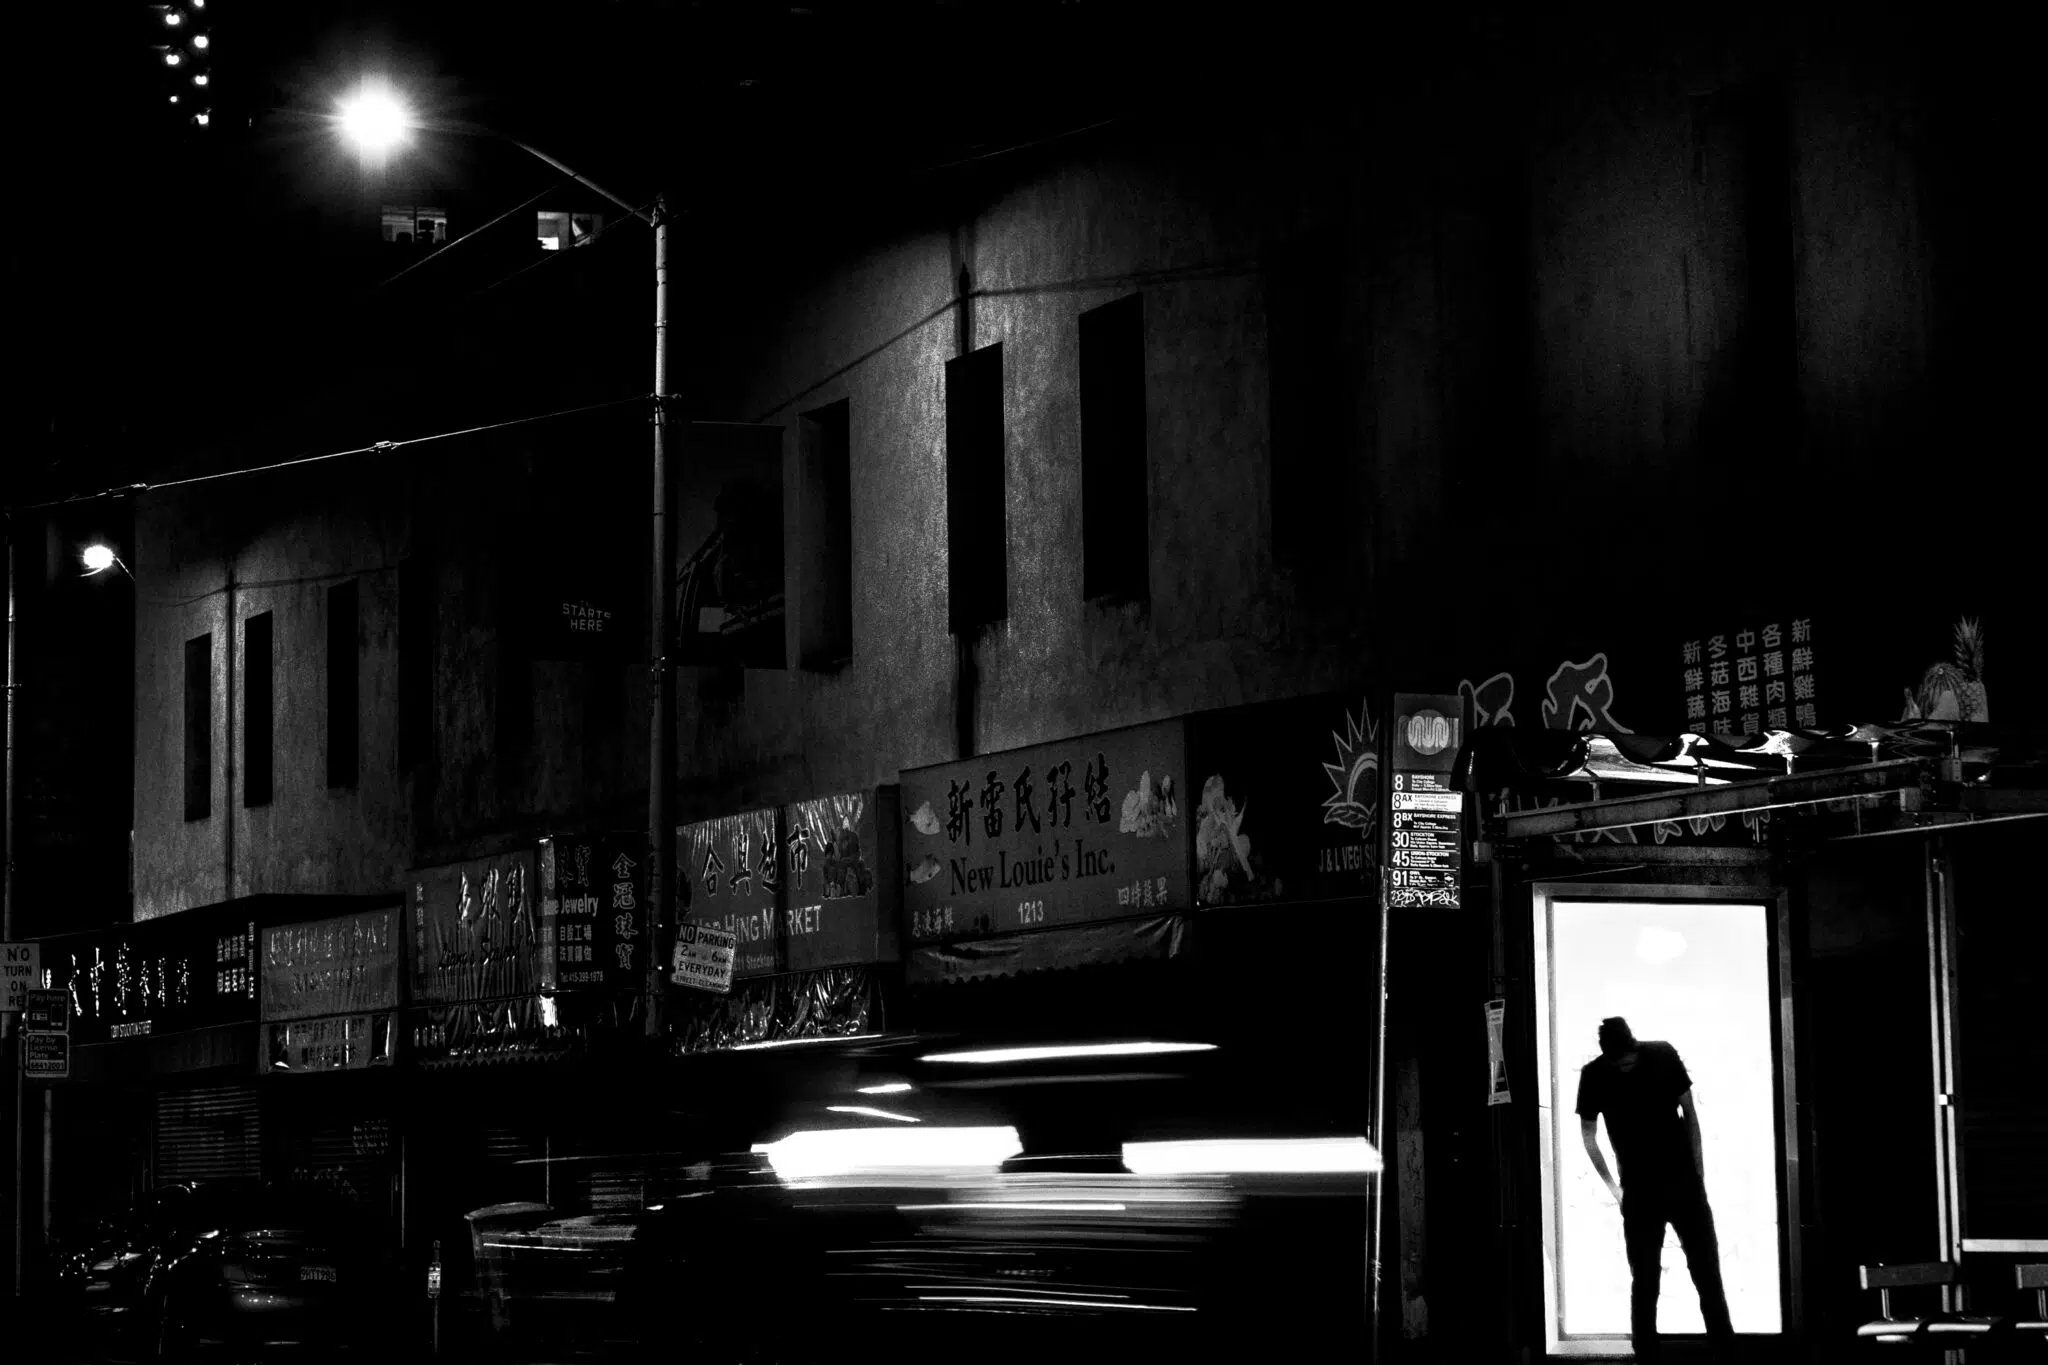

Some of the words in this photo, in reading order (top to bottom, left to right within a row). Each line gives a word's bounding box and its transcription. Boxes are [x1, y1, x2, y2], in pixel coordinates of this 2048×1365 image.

[570, 619, 605, 633] HERE
[1394, 774, 1404, 791] 8
[1392, 831, 1410, 848] 30
[1392, 850, 1410, 867] 45
[950, 857, 995, 896] New
[999, 839, 1070, 889] Louie's
[1075, 839, 1116, 879] Inc.
[1392, 870, 1408, 886] 91
[560, 892, 599, 918] Jewelry
[1017, 900, 1044, 925] 1213
[679, 924, 695, 944] NO
[697, 931, 735, 950] PARKING
[7, 947, 30, 962] NO
[4, 965, 32, 977] TURN
[678, 960, 727, 979] EVERYDAY
[10, 980, 27, 993] ON
